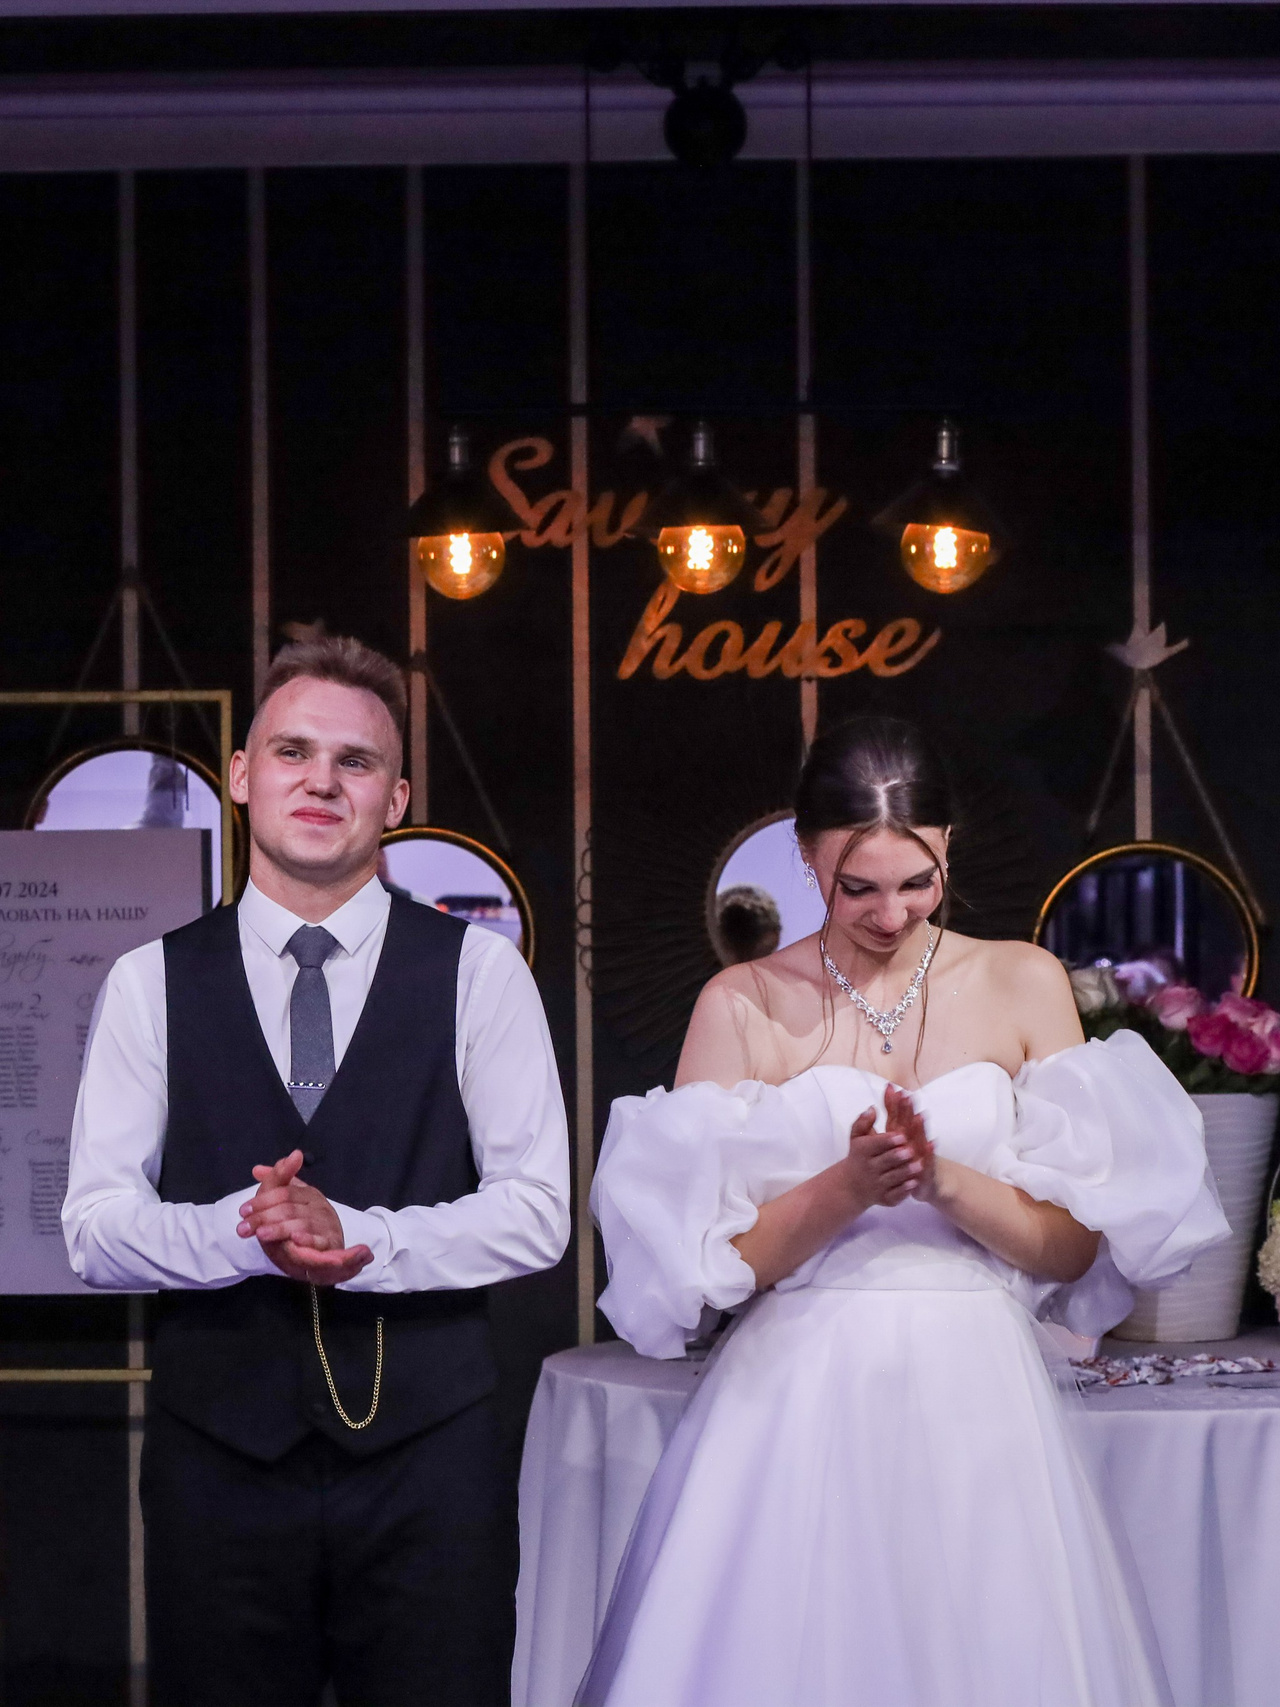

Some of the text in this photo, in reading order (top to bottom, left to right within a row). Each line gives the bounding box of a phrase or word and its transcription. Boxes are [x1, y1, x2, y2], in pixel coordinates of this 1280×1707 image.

[487, 436, 848, 592] Savy
[616, 577, 941, 681] house
[67, 907, 92, 922] НА
[96, 906, 149, 922] НАШУ
